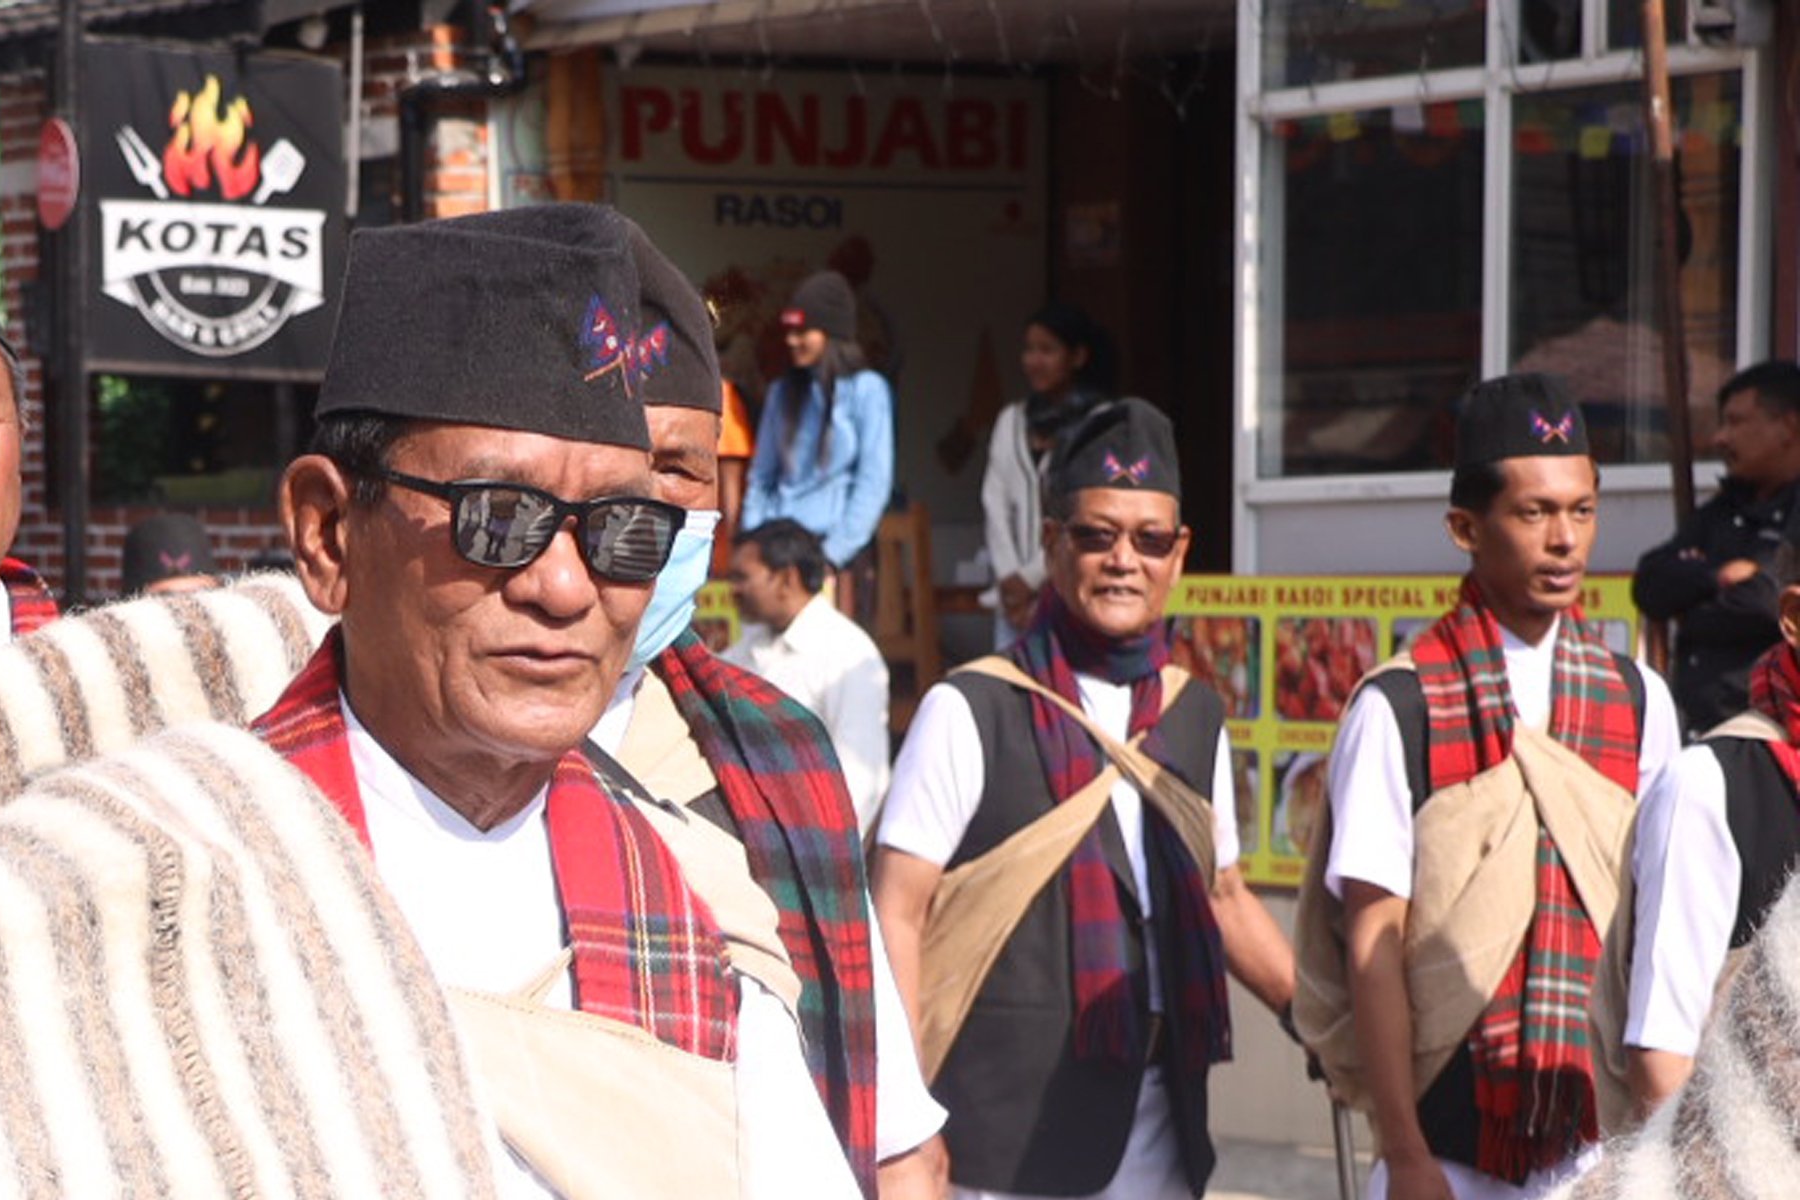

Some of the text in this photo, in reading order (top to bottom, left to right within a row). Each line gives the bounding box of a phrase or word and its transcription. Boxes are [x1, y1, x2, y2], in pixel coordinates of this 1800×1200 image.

[618, 84, 1029, 171] PUNJABI
[715, 194, 843, 228] RASOI
[116, 218, 310, 260] KOTAS
[1185, 585, 1267, 608] PUNJABI
[1275, 586, 1333, 609] RASOI
[1342, 586, 1426, 609] SPECIAL
